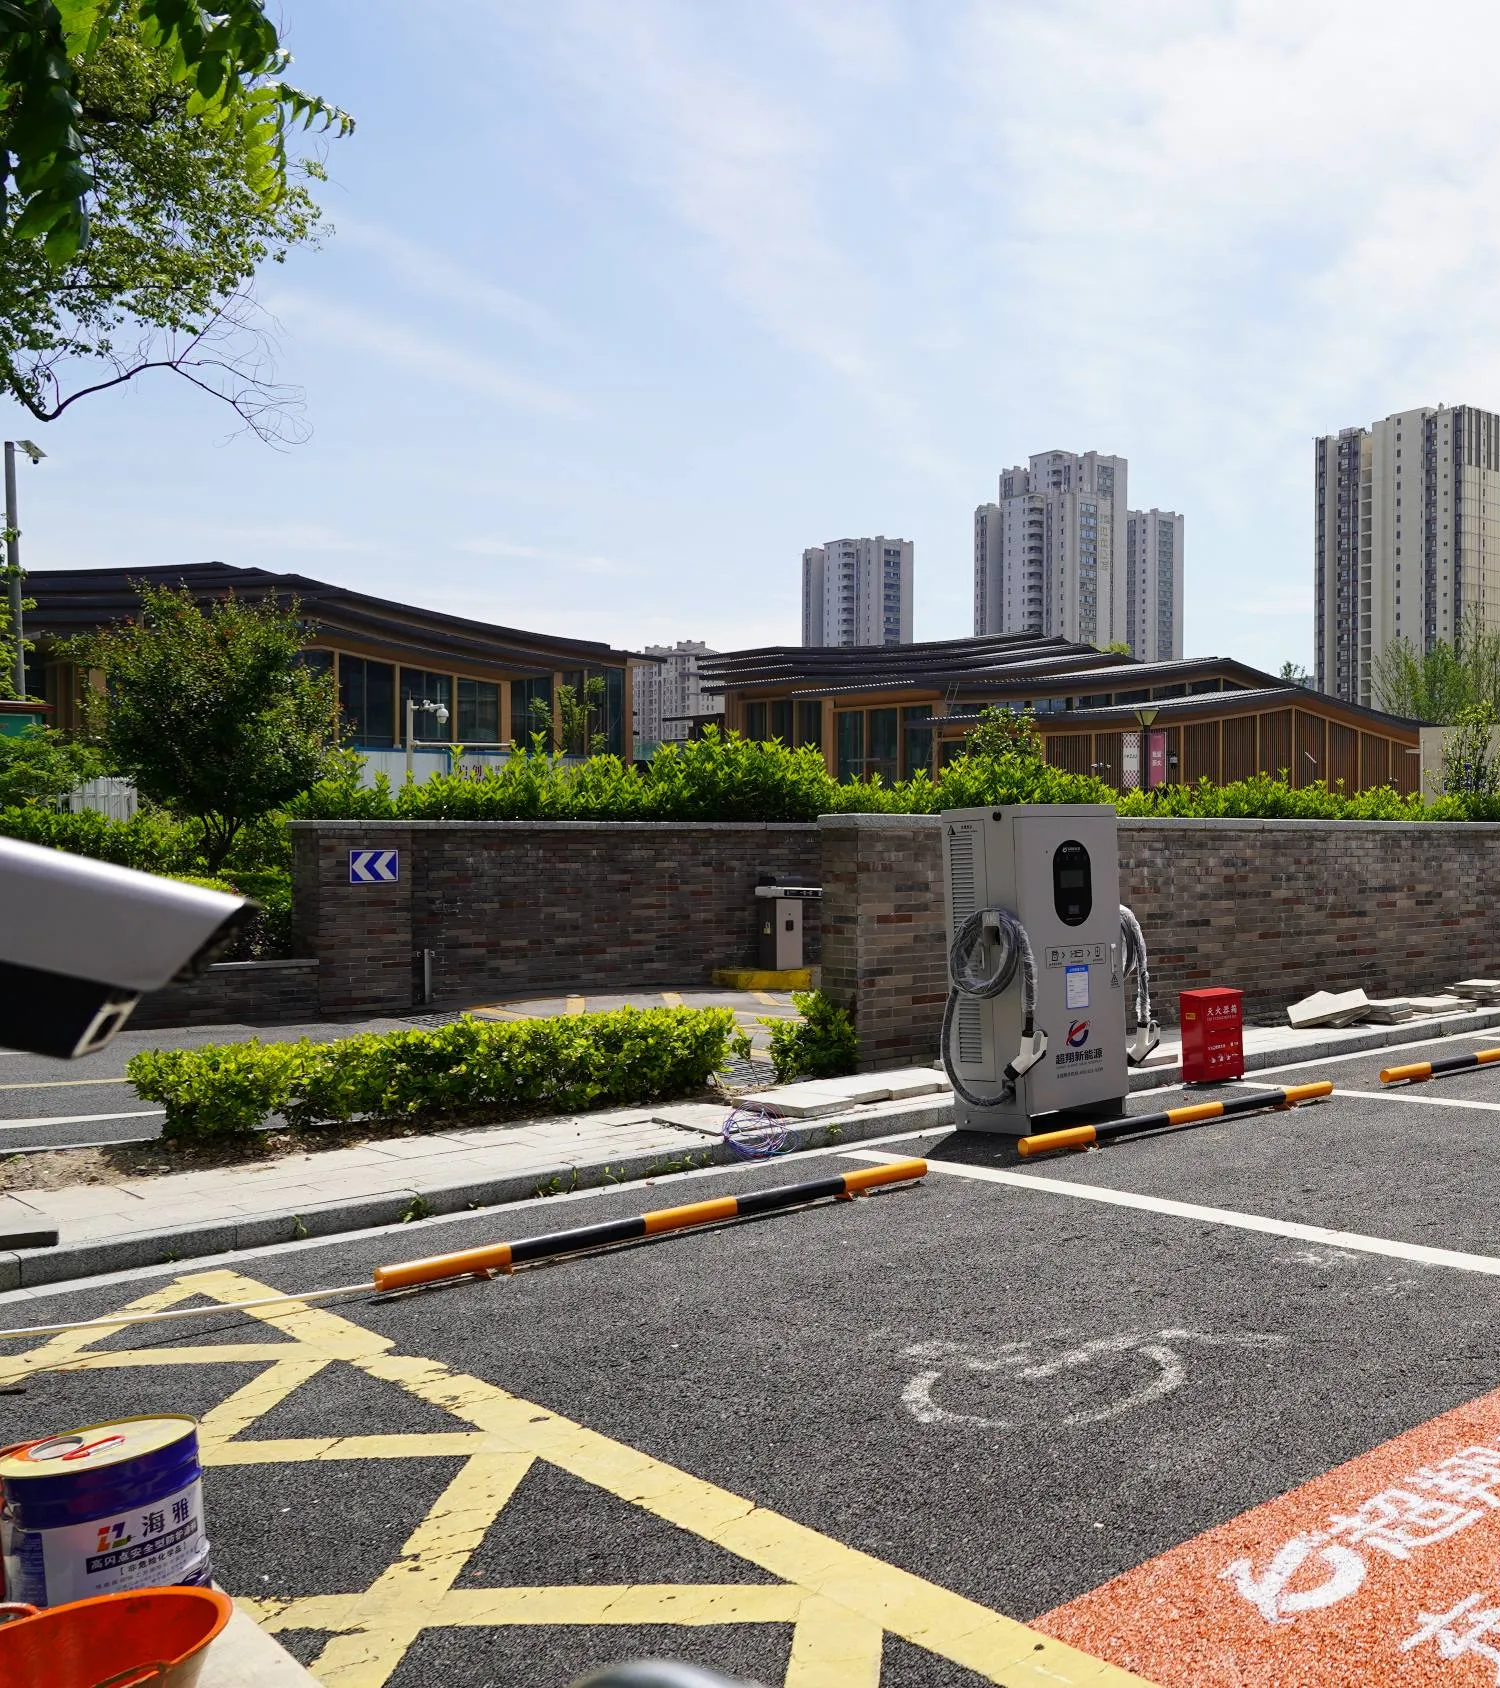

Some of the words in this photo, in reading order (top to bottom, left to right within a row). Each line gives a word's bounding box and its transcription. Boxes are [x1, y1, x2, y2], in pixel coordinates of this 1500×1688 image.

[1056, 1048, 1103, 1065] 超翔新能源
[142, 1497, 190, 1537] 海雅
